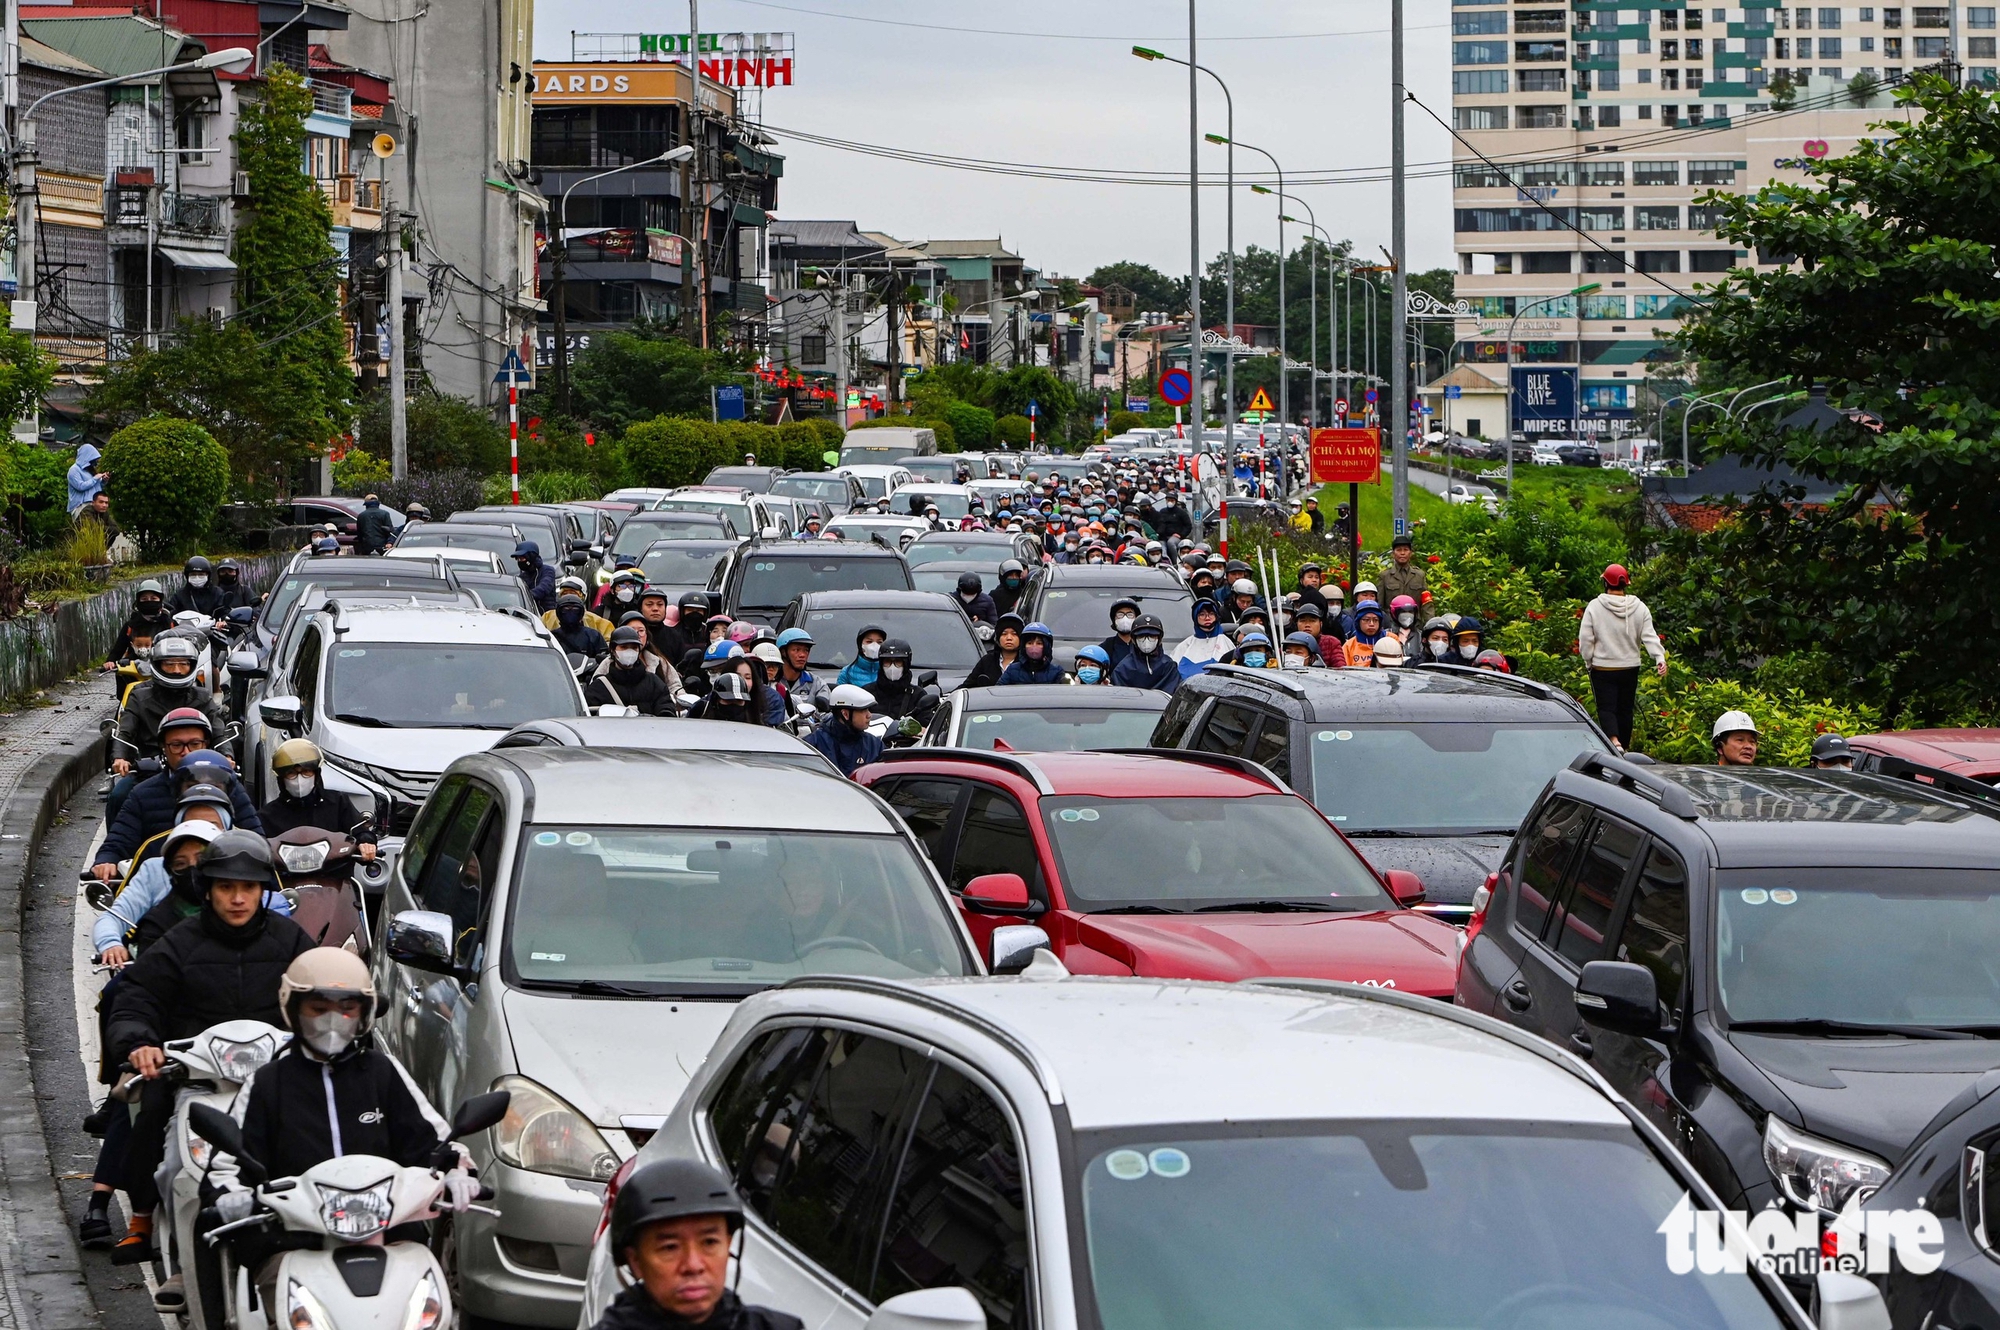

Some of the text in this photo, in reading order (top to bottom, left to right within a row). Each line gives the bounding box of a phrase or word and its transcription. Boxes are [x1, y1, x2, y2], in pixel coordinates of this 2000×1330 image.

[640, 34, 723, 52] HOTEL
[1521, 321, 1561, 330] PALACE
[1527, 374, 1551, 390] BLUE
[1527, 389, 1545, 405] BAY
[1523, 419, 1566, 432] MIPEC
[1571, 419, 1607, 432] LONG
[1313, 444, 1342, 455] CHÙA
[1344, 444, 1355, 455] ÁI
